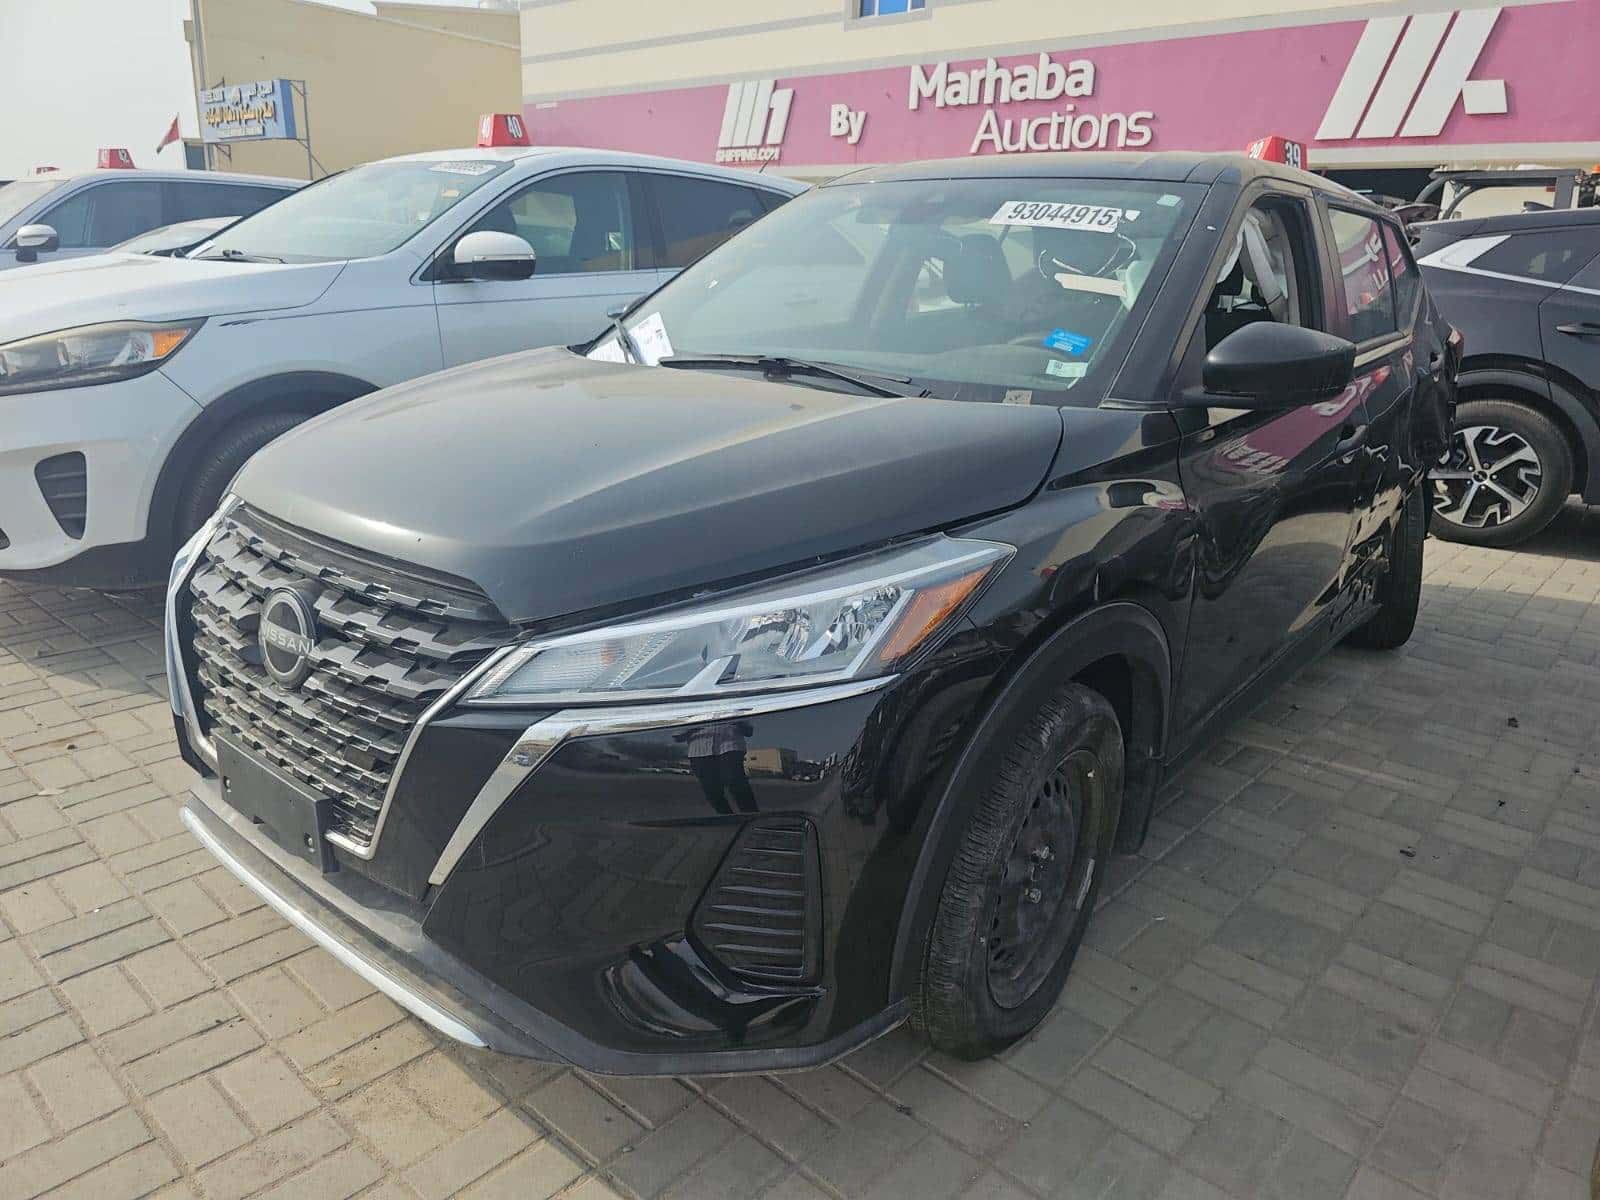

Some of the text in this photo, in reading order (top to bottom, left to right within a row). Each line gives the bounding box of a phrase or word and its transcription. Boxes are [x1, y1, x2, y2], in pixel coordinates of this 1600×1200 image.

[909, 52, 1095, 110] Marhaba
[830, 103, 866, 145] By
[970, 104, 1154, 154] Auctions
[1285, 142, 1302, 169] 39
[1007, 202, 1118, 226] 93044915
